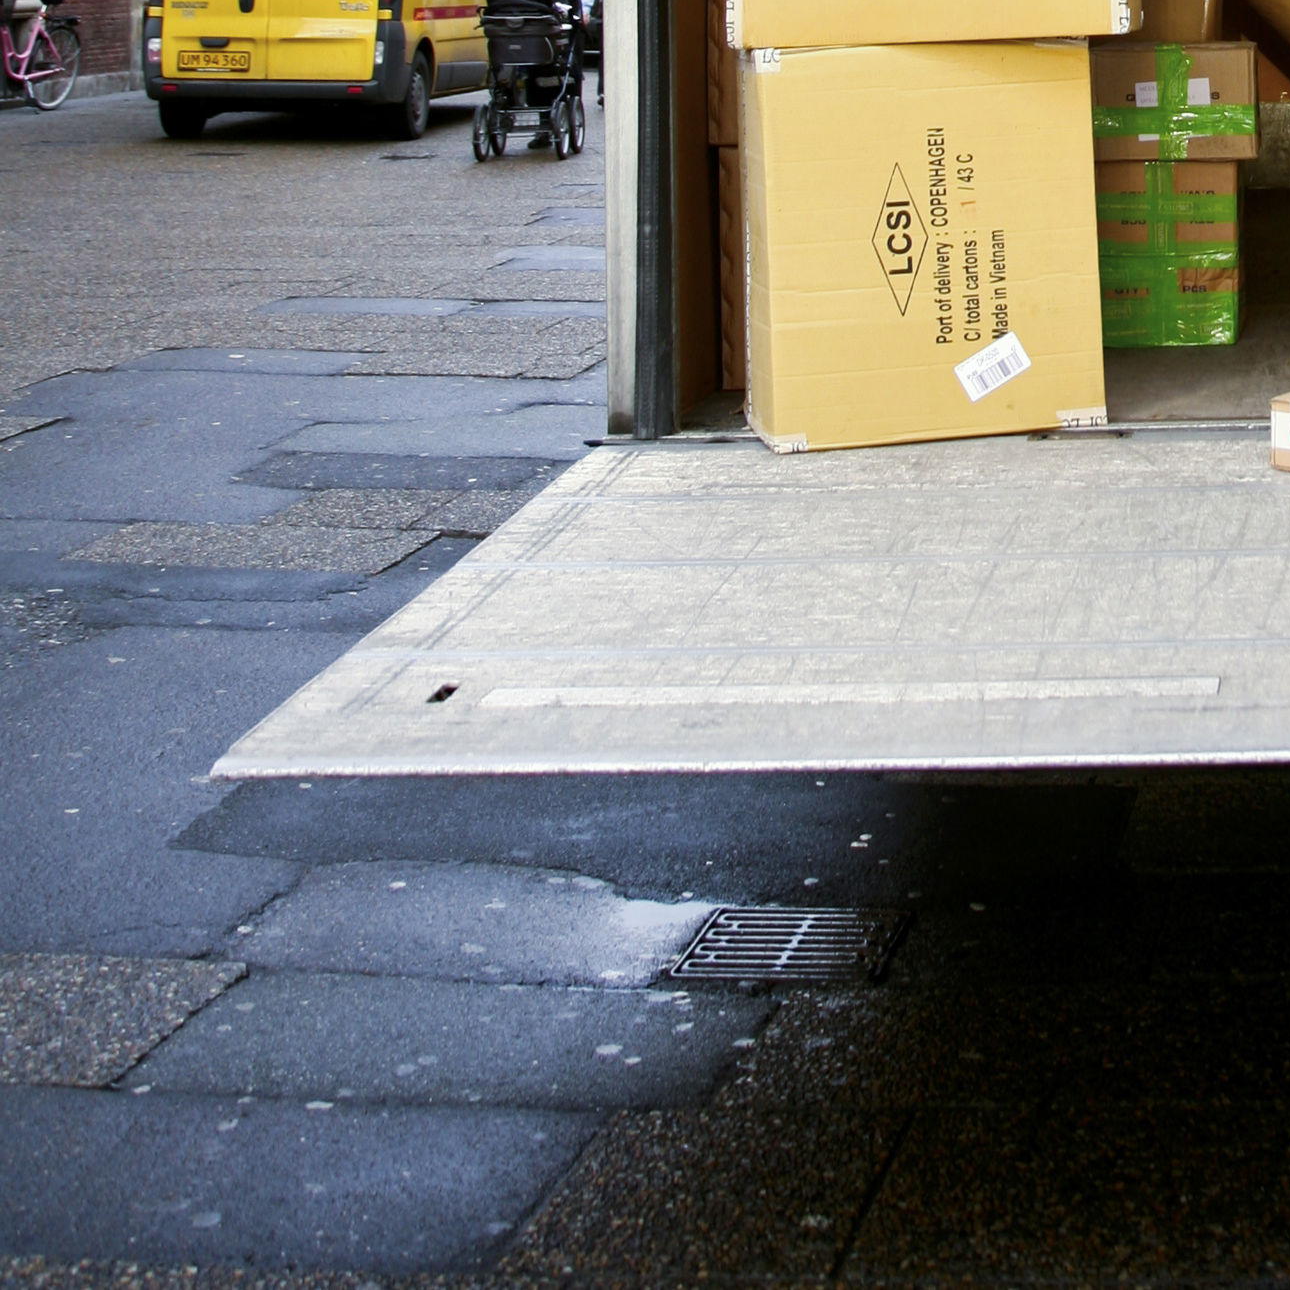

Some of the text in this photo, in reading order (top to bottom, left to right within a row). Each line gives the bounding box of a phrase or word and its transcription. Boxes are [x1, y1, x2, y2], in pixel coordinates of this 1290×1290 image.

[181, 54, 201, 66] UM
[221, 54, 247, 67] 360
[762, 49, 779, 63] LC
[956, 153, 974, 164] C
[927, 127, 948, 228] COPENHAGEN
[957, 168, 974, 183] 43
[886, 200, 913, 276] LCSI
[932, 242, 954, 294] delivery
[963, 240, 980, 292] cartons
[989, 229, 1008, 340] Made in Vietnam
[935, 295, 952, 310] of
[962, 294, 981, 327] total
[936, 313, 953, 344] Port
[963, 327, 981, 342] C/
